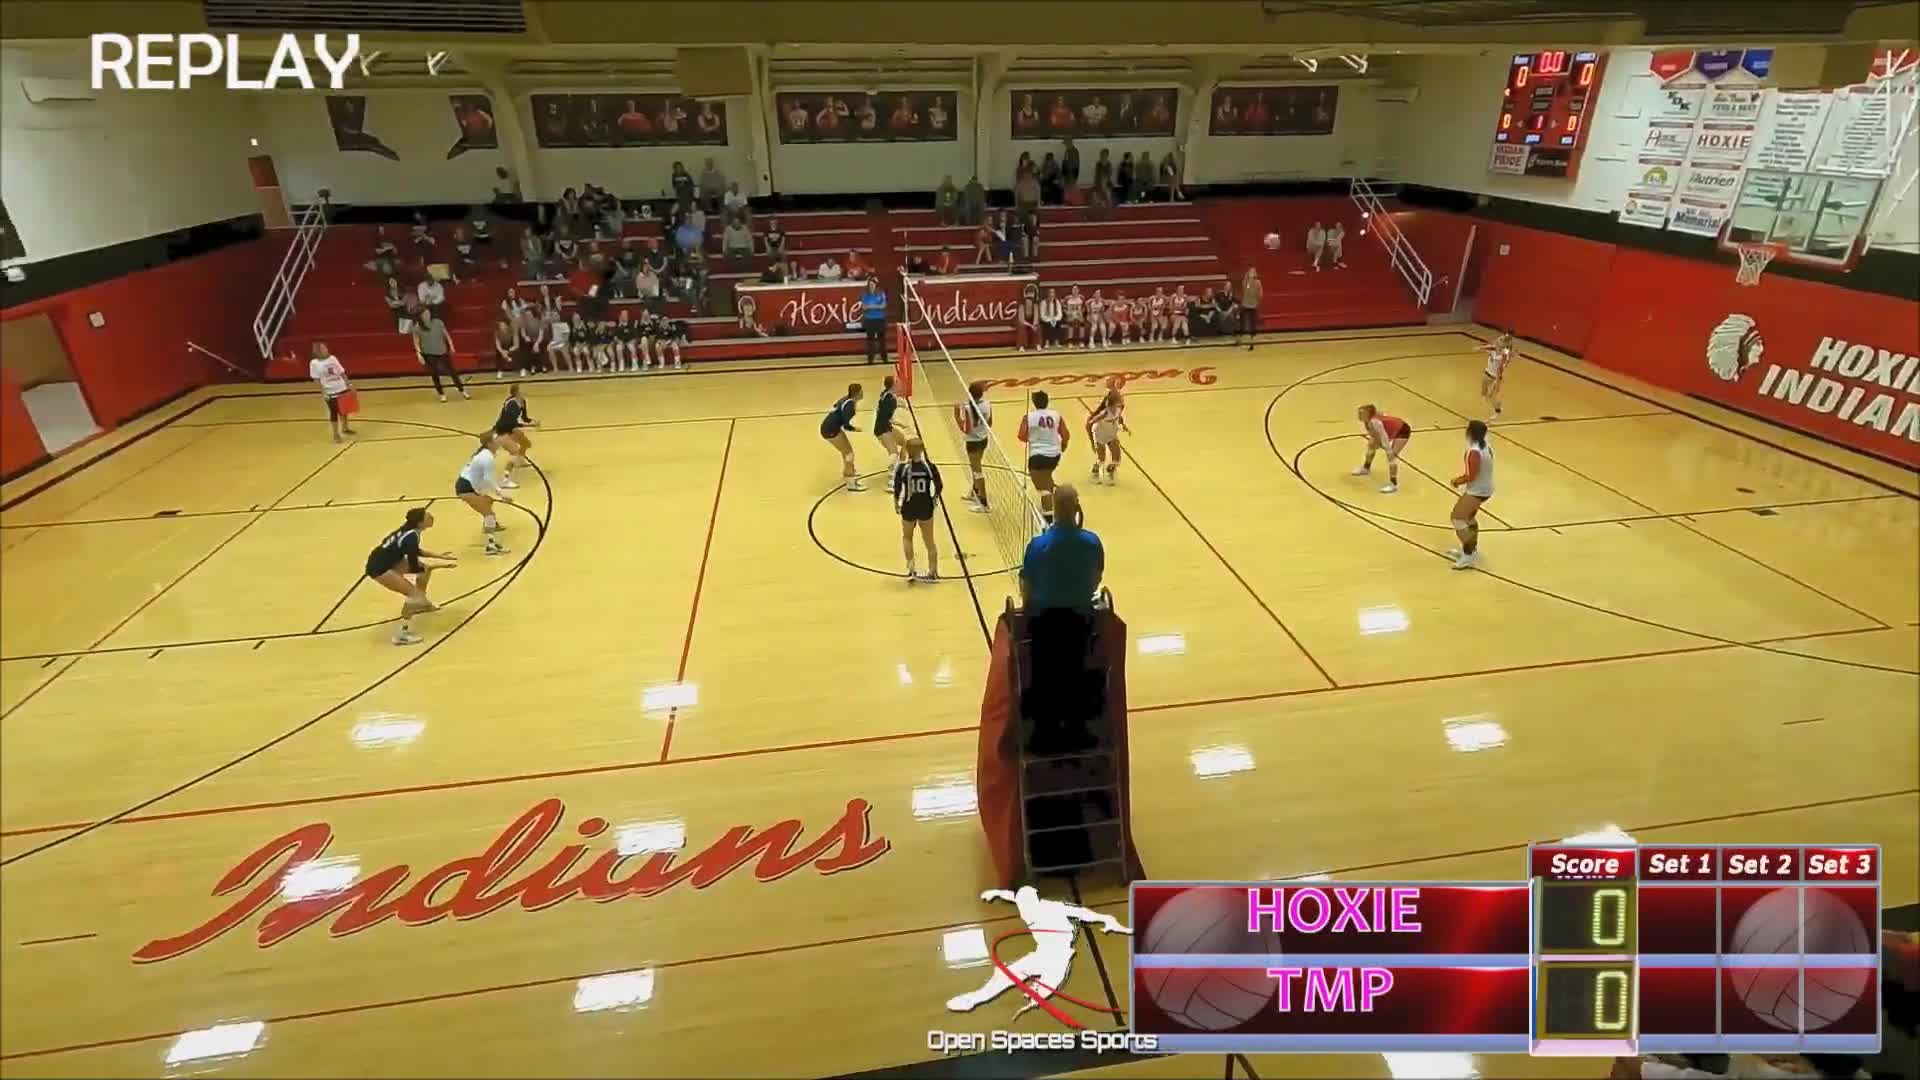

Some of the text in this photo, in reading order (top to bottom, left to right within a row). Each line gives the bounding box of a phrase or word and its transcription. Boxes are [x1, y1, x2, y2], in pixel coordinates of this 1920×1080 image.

[1516, 66, 1529, 87] 0
[1580, 63, 1594, 86] 0
[1503, 113, 1512, 129] 0
[1567, 115, 1577, 131] 0
[1697, 135, 1752, 149] HOXIE
[780, 292, 864, 327] Hoxie
[1038, 415, 1055, 429] 40
[131, 798, 890, 964] Indians
